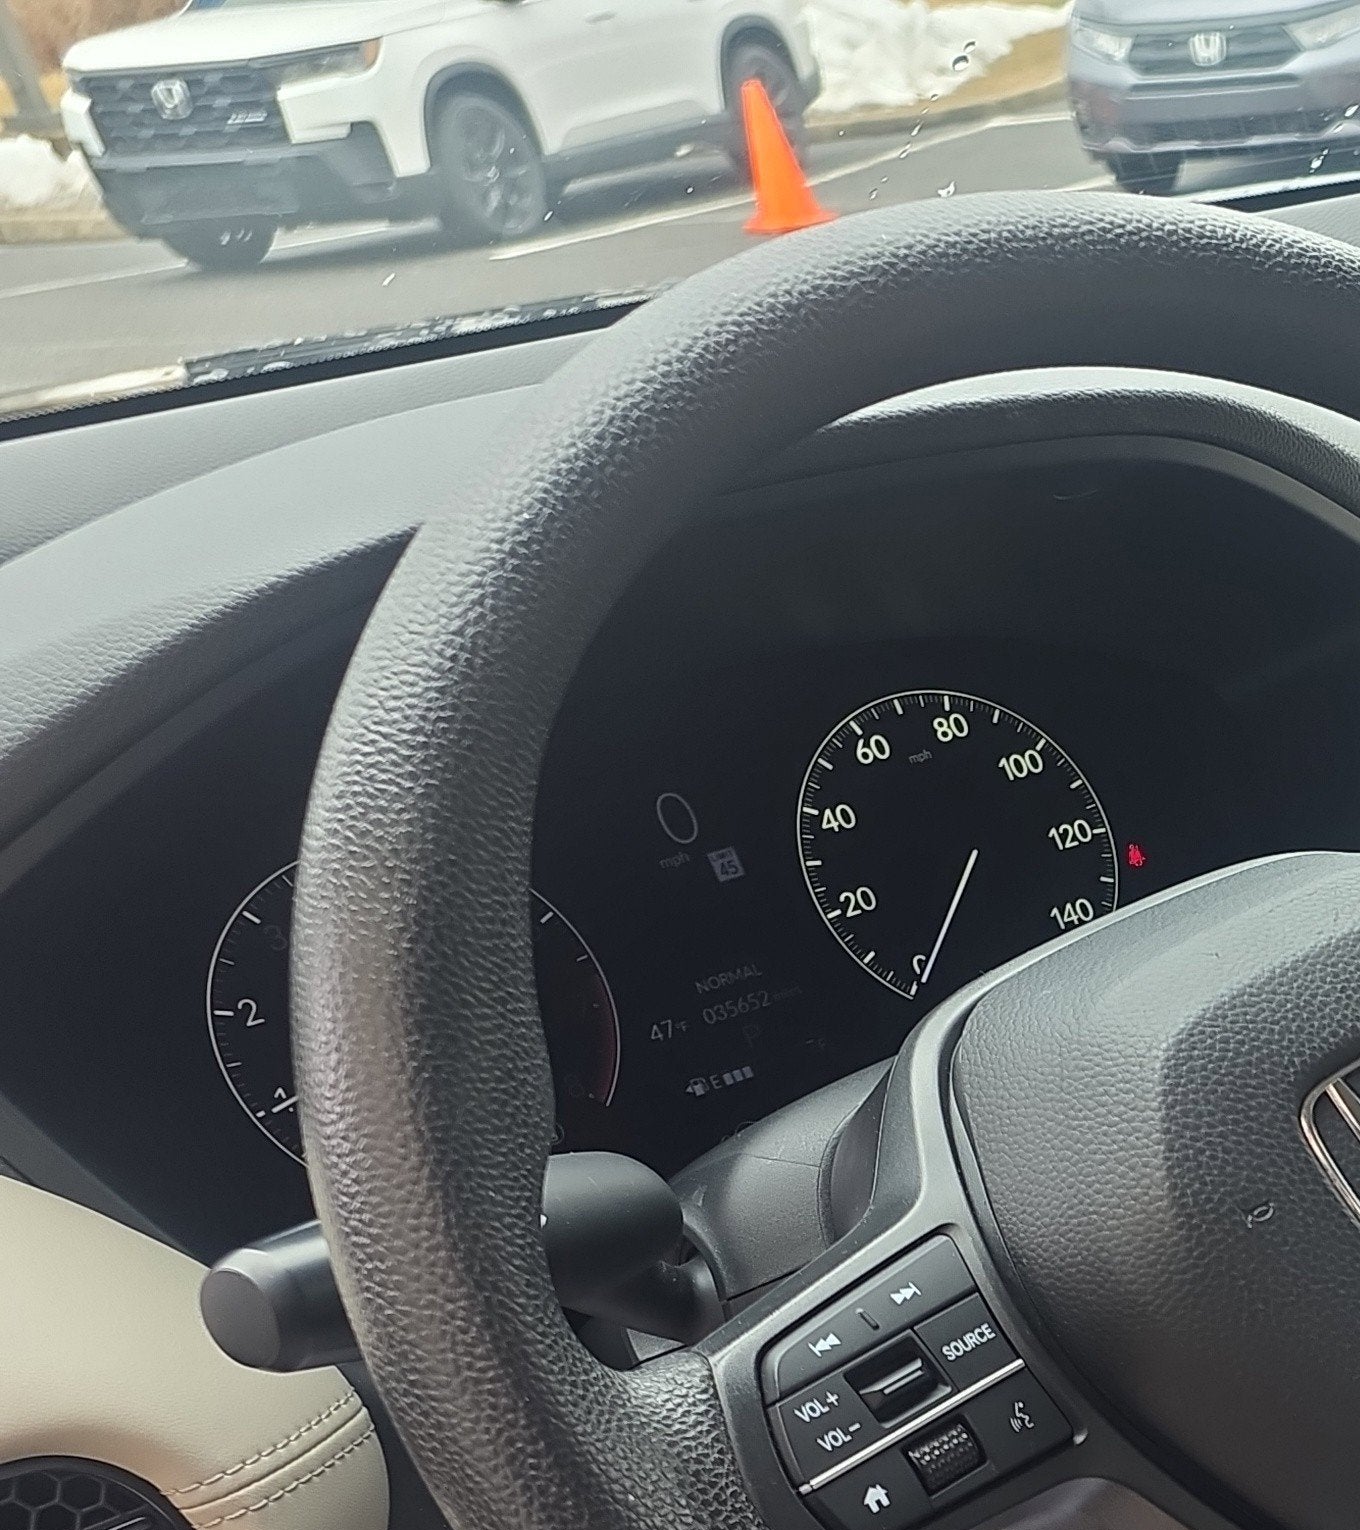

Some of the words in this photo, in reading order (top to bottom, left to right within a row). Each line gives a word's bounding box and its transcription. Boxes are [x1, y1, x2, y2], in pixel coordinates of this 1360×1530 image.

[931, 711, 970, 743] 80
[854, 733, 892, 765] 60
[997, 747, 1044, 783] 100
[656, 792, 699, 844] 0
[819, 802, 857, 833] 40
[1047, 818, 1094, 851] 120
[658, 851, 691, 871] mph
[838, 886, 878, 918] 20
[1049, 898, 1095, 931] 140
[695, 963, 764, 994] NORMAL
[236, 998, 266, 1028] 2
[702, 989, 774, 1025] 035652
[709, 1073, 723, 1090] E
[941, 1322, 997, 1362] SOURCE
[794, 1390, 840, 1424] VOL+
